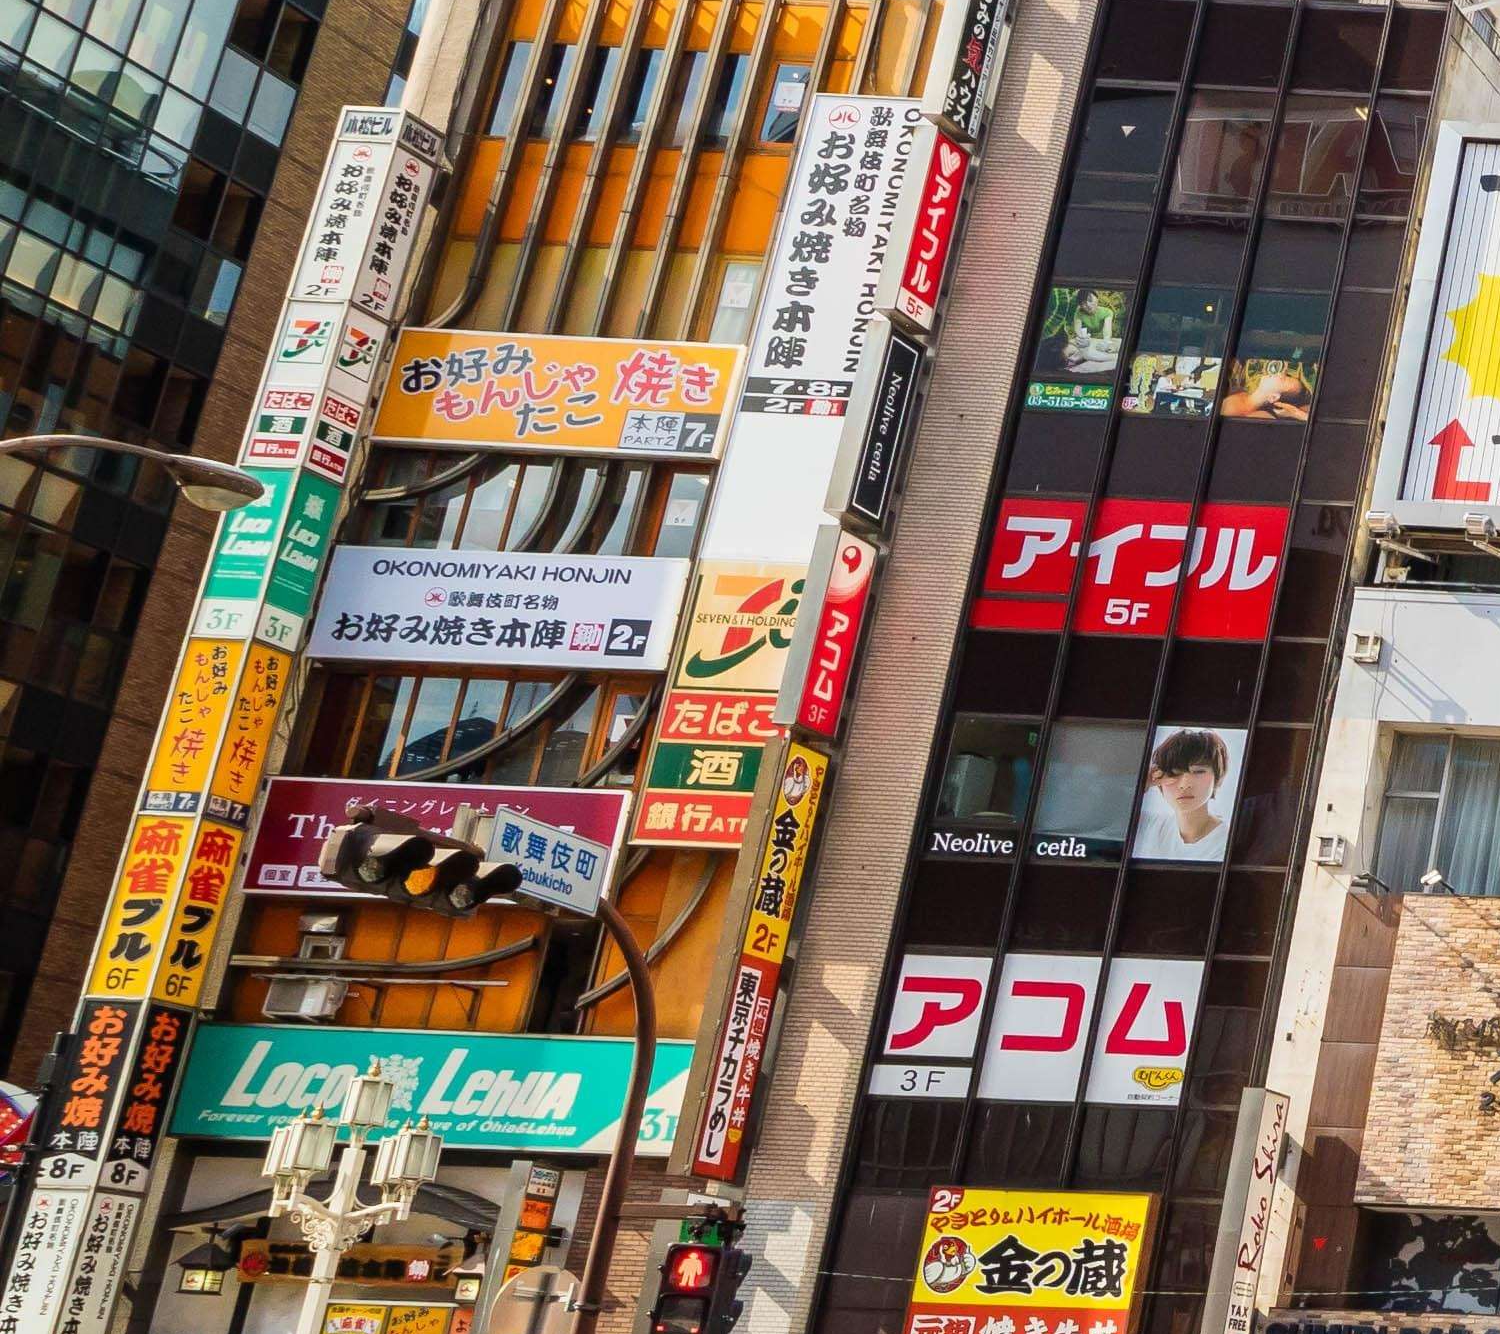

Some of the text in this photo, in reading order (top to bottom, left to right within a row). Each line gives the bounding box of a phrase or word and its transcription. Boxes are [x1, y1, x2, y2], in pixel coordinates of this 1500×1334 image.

[843, 106, 895, 238] 歌舞伎町名物
[764, 131, 856, 369] お好み焼き本陣
[910, 176, 951, 295] アイフル
[612, 349, 718, 406] 焼き
[265, 391, 311, 410] たばこ
[762, 398, 804, 413] 2F
[684, 421, 714, 450] 7F
[1000, 515, 1278, 592] アイフル
[371, 559, 631, 586] OKONOMIYAKI HONJIN
[447, 588, 559, 610] 歌舞伎町名物
[1104, 598, 1150, 626] 5F
[333, 611, 564, 650] お好み焼き本陣
[611, 620, 649, 652] 2F
[808, 703, 828, 725] 3F
[686, 749, 743, 786] 酒
[499, 821, 600, 881] 歌舞伎町
[930, 831, 1087, 858] Neolive cetla
[752, 922, 781, 954] 2F
[104, 968, 137, 990] 6F
[165, 975, 191, 997] 6F
[888, 975, 1189, 1059] アコム
[62, 1005, 128, 1129] お好み焼
[698, 971, 763, 1161] 東京チカラめし
[900, 1069, 943, 1093] 3F
[49, 1130, 100, 1151] 本陣
[50, 1157, 85, 1181] 8F
[109, 1161, 138, 1185] 8F
[976, 1234, 1128, 1298] 金の蔵
[1227, 1304, 1248, 1332] TAX FREE
